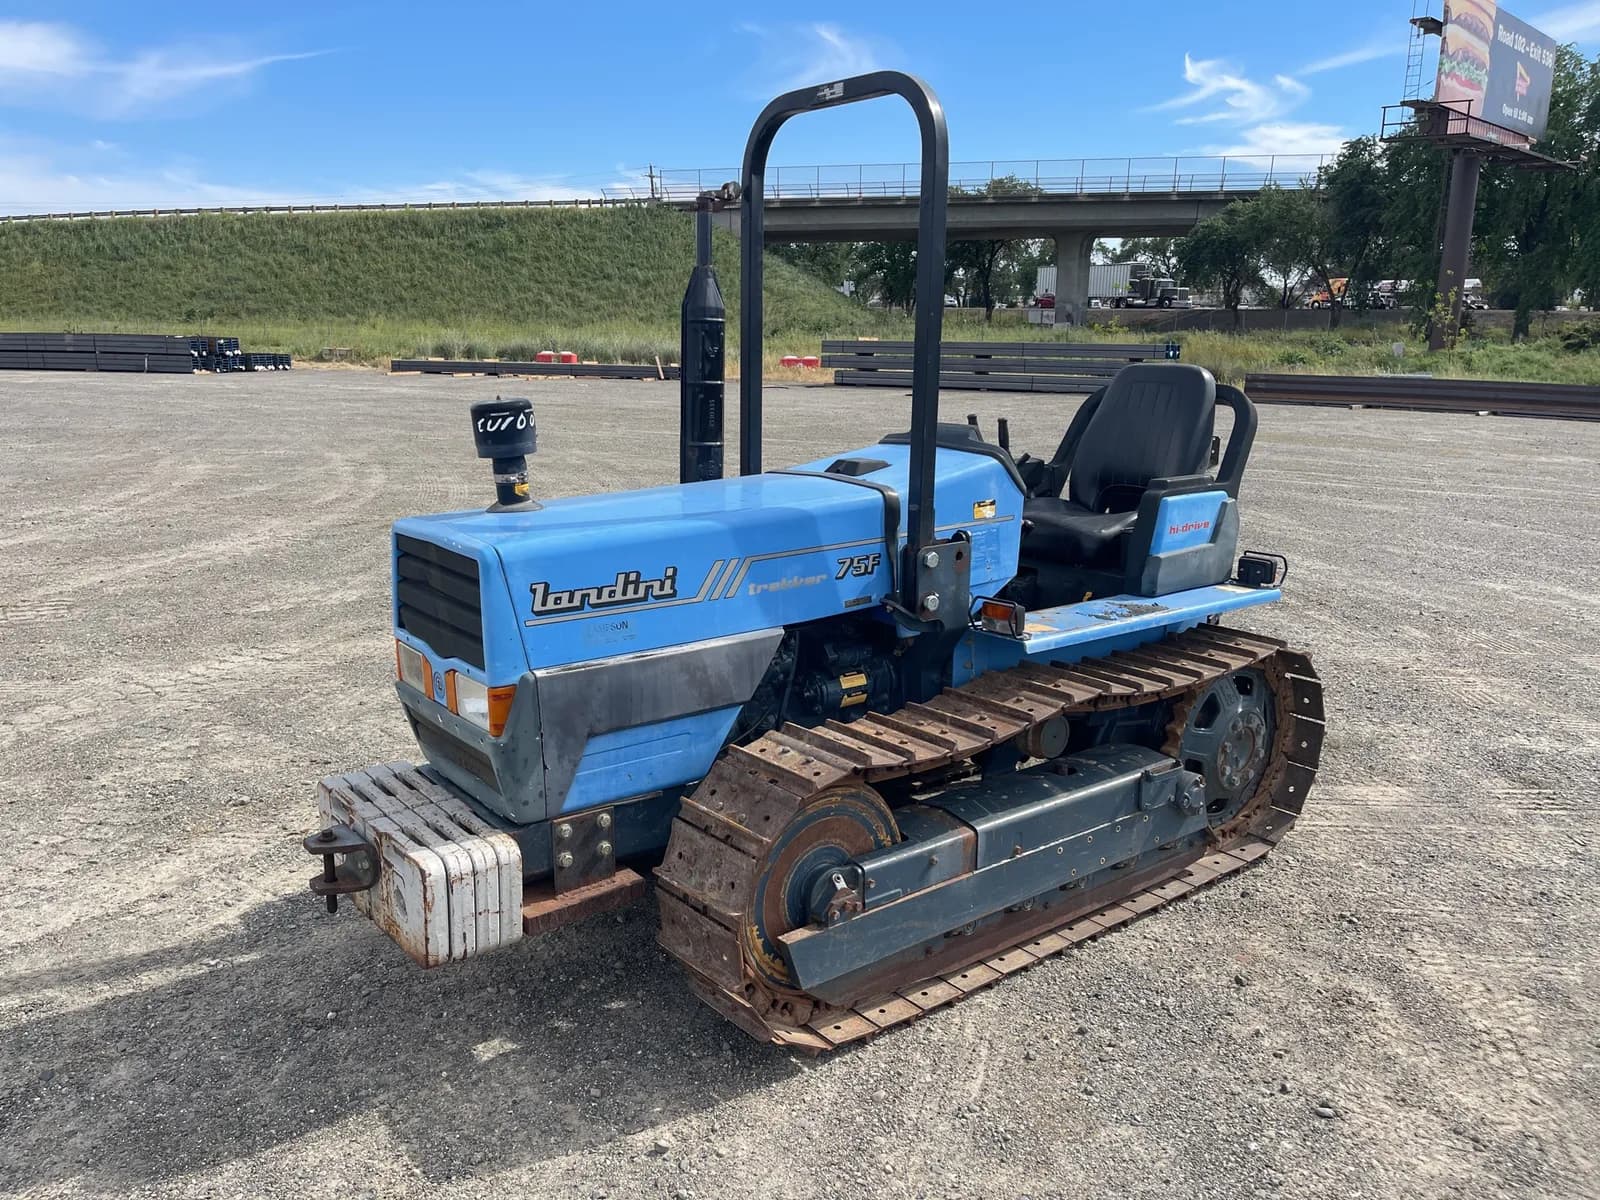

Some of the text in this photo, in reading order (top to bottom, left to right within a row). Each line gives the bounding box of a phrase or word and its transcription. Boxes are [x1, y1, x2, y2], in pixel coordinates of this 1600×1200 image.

[1498, 23, 1515, 48] Road
[1514, 33, 1526, 53] 102
[1530, 42, 1541, 63] Exit
[1502, 103, 1513, 117] Open
[1168, 521, 1210, 535] hi-drive
[835, 552, 881, 580] 75F
